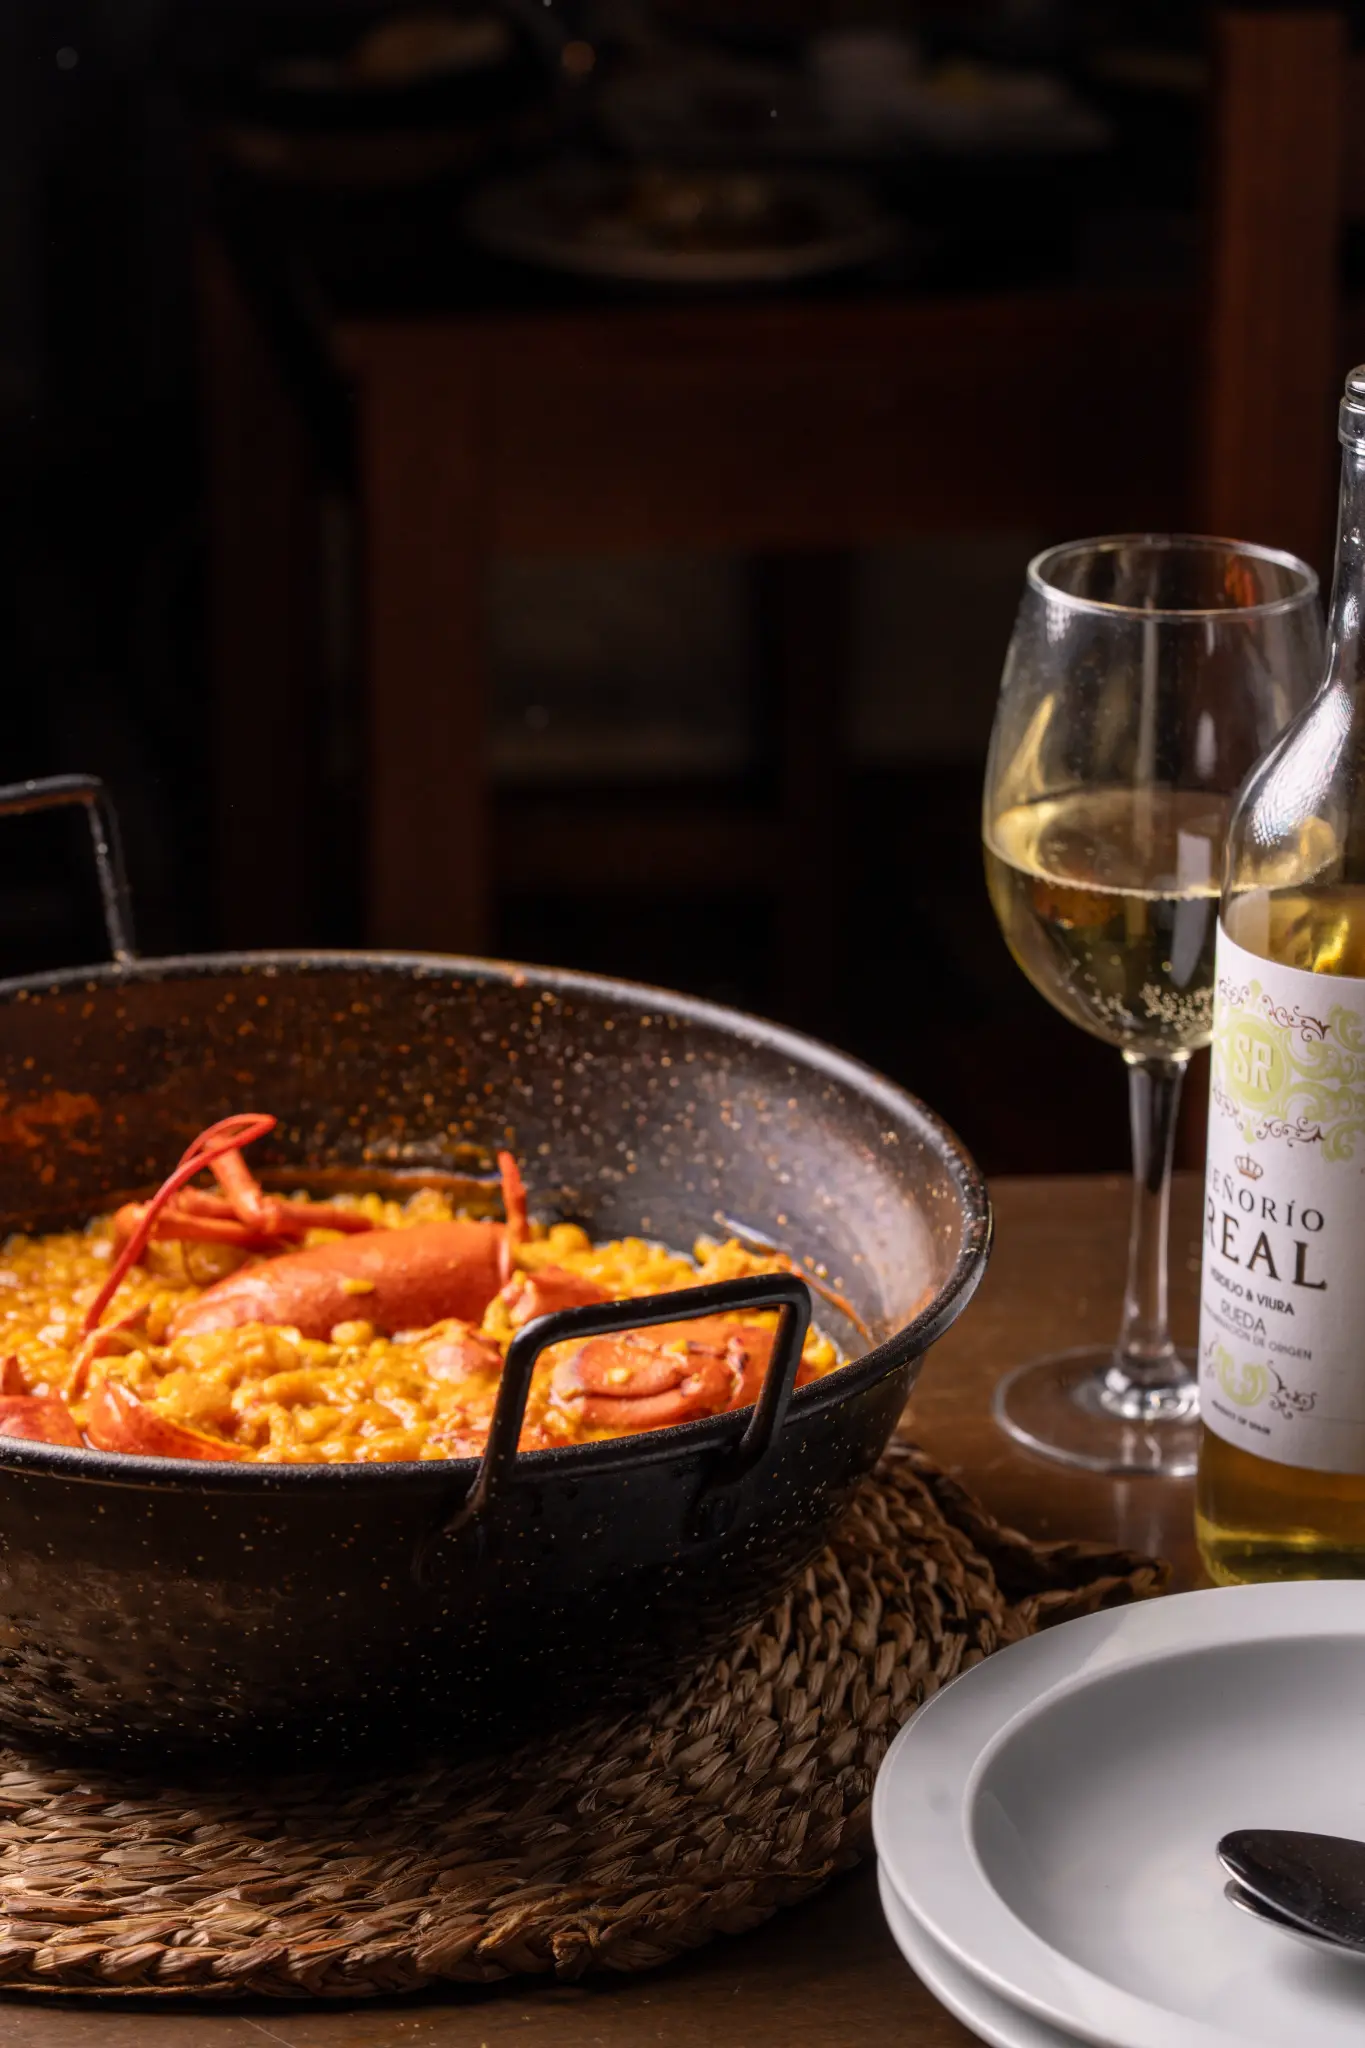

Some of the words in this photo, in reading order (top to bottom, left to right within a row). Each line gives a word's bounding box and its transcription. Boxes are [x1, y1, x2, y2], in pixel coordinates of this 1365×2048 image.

[1233, 1033, 1275, 1092] SR
[1207, 1162, 1325, 1232] EÑORÍO
[1256, 1293, 1296, 1316] VIURA
[1268, 1340, 1313, 1361] ORIGEN
